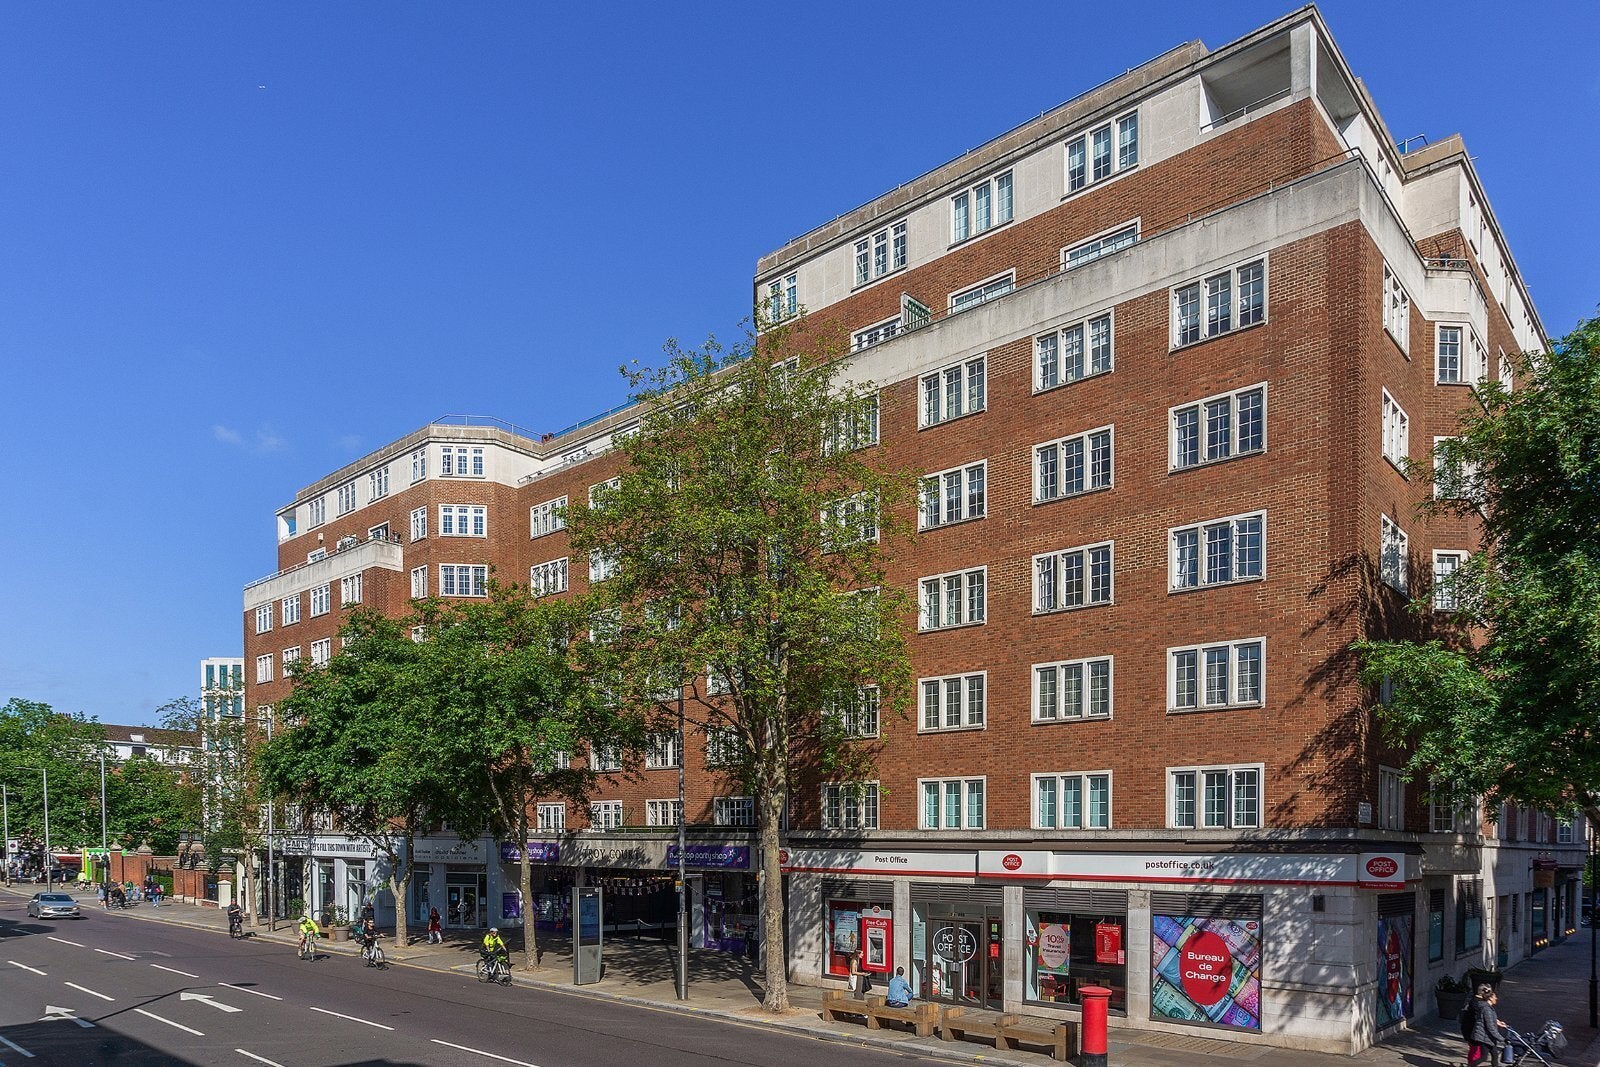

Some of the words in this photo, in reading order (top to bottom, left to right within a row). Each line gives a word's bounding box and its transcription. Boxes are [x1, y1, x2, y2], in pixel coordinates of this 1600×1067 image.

[327, 843, 335, 852] THIS
[335, 843, 346, 852] TOWN
[346, 843, 356, 852] WITH
[583, 848, 605, 859] TROY
[609, 848, 640, 860] COURT
[889, 856, 908, 864] Office
[1145, 860, 1215, 870] postoffice.co.uk
[942, 933, 969, 944] POST
[937, 943, 971, 954] OFFICE
[1187, 952, 1224, 962] Bureau
[1198, 962, 1213, 971] de
[1185, 971, 1226, 983] Change
